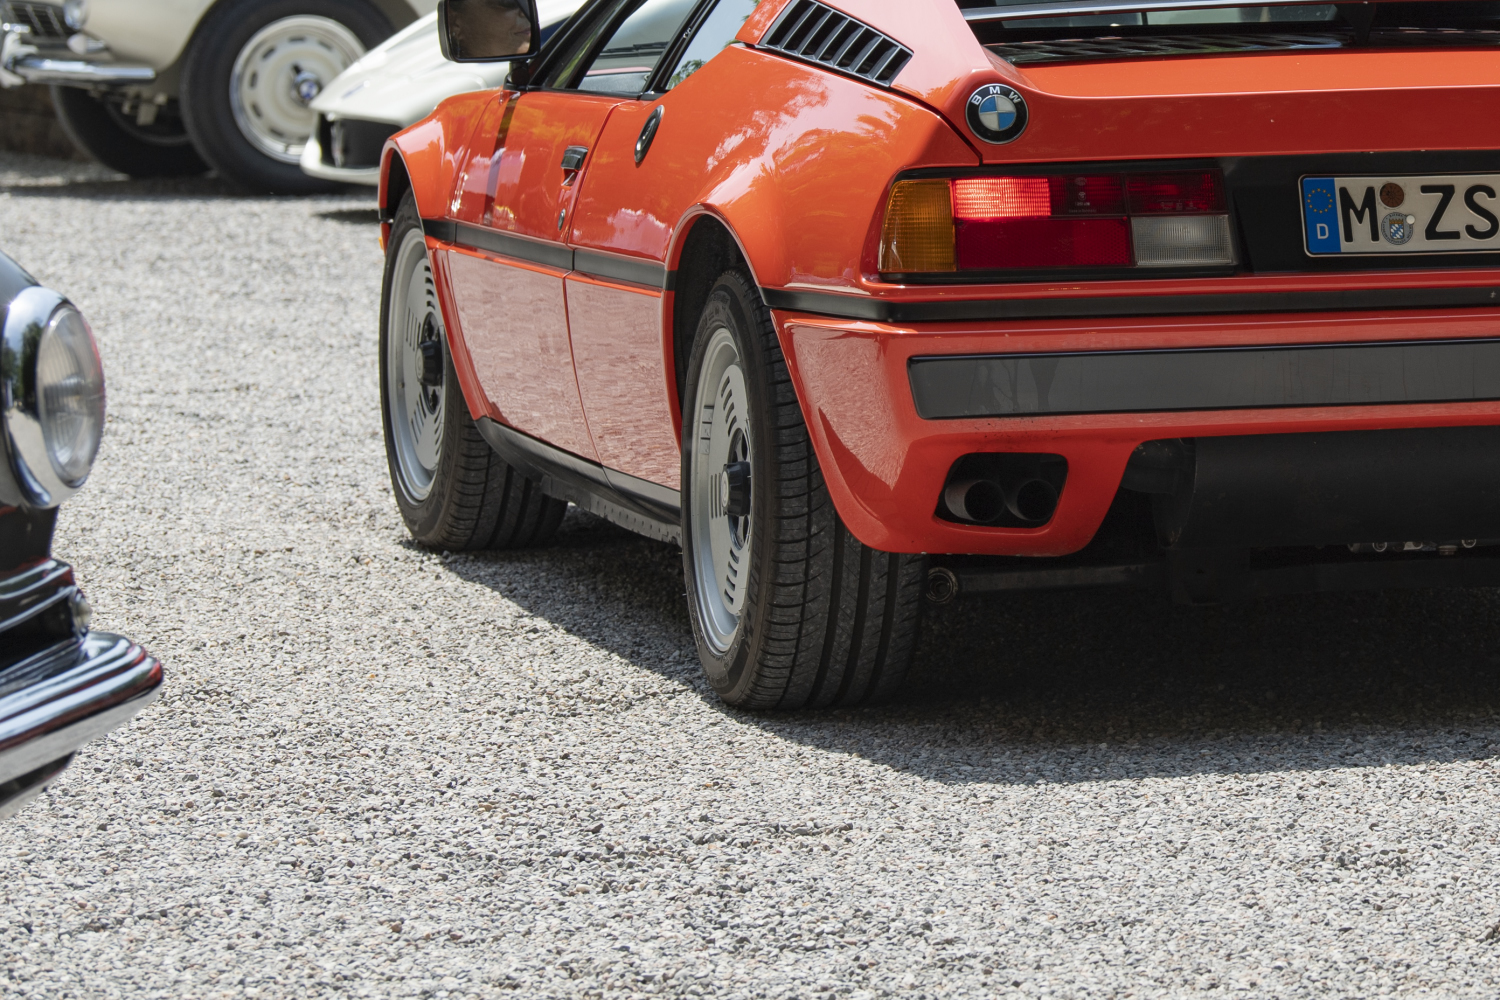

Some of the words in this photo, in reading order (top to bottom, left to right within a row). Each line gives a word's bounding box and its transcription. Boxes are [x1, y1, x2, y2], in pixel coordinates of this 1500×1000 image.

[971, 86, 1021, 105] BMW
[1339, 186, 1379, 242] M
[1420, 184, 1500, 241] ZS
[1316, 223, 1329, 239] D
